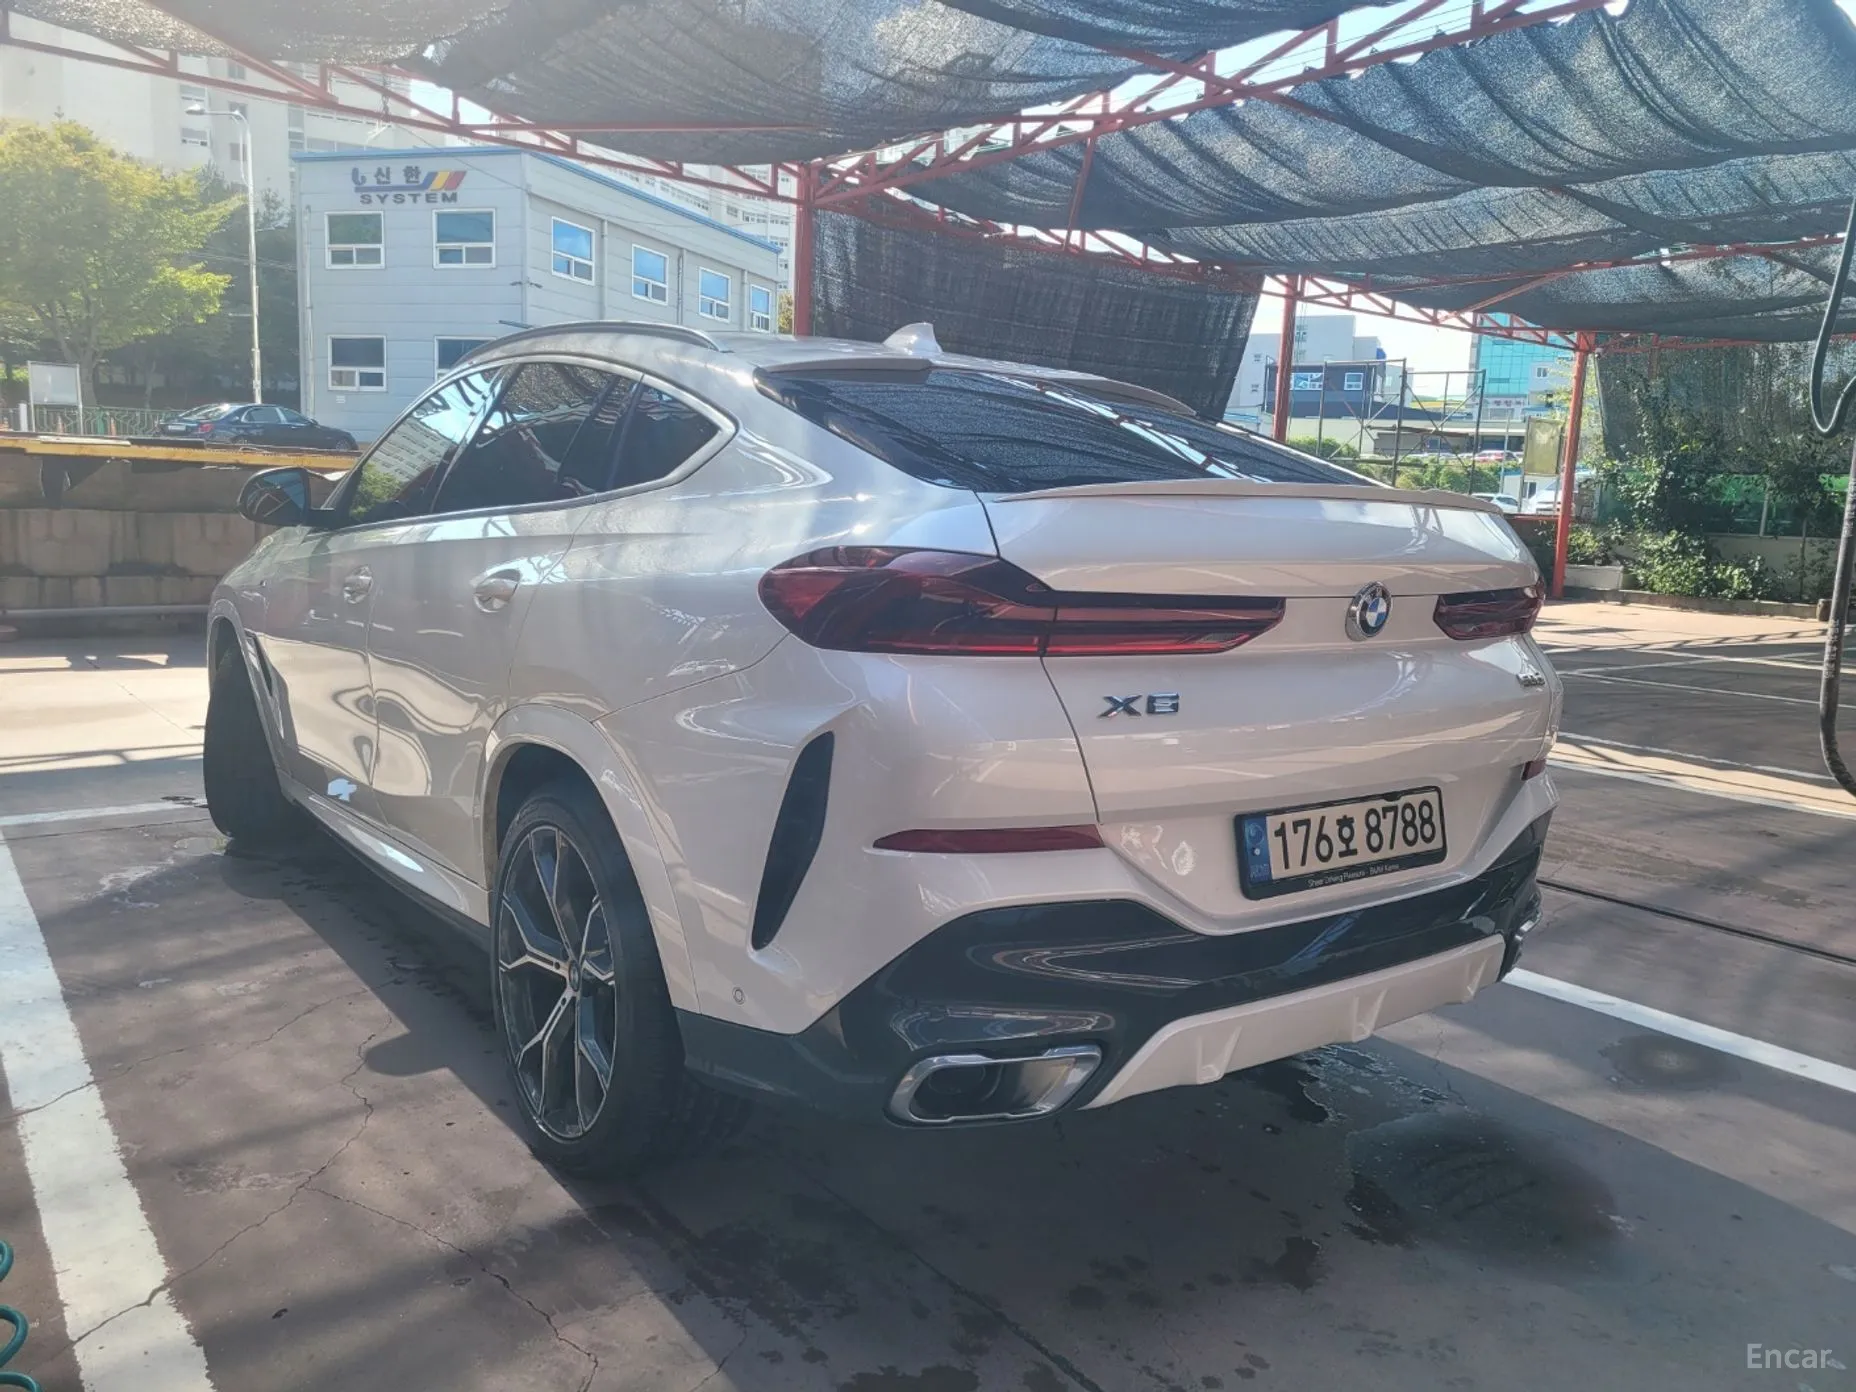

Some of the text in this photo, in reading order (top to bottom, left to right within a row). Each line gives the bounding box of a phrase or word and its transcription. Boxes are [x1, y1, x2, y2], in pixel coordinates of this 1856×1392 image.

[374, 166, 421, 184] 신한
[360, 192, 458, 204] SYSTEM
[1098, 692, 1180, 718] X6
[1274, 800, 1436, 870] 176호 8788
